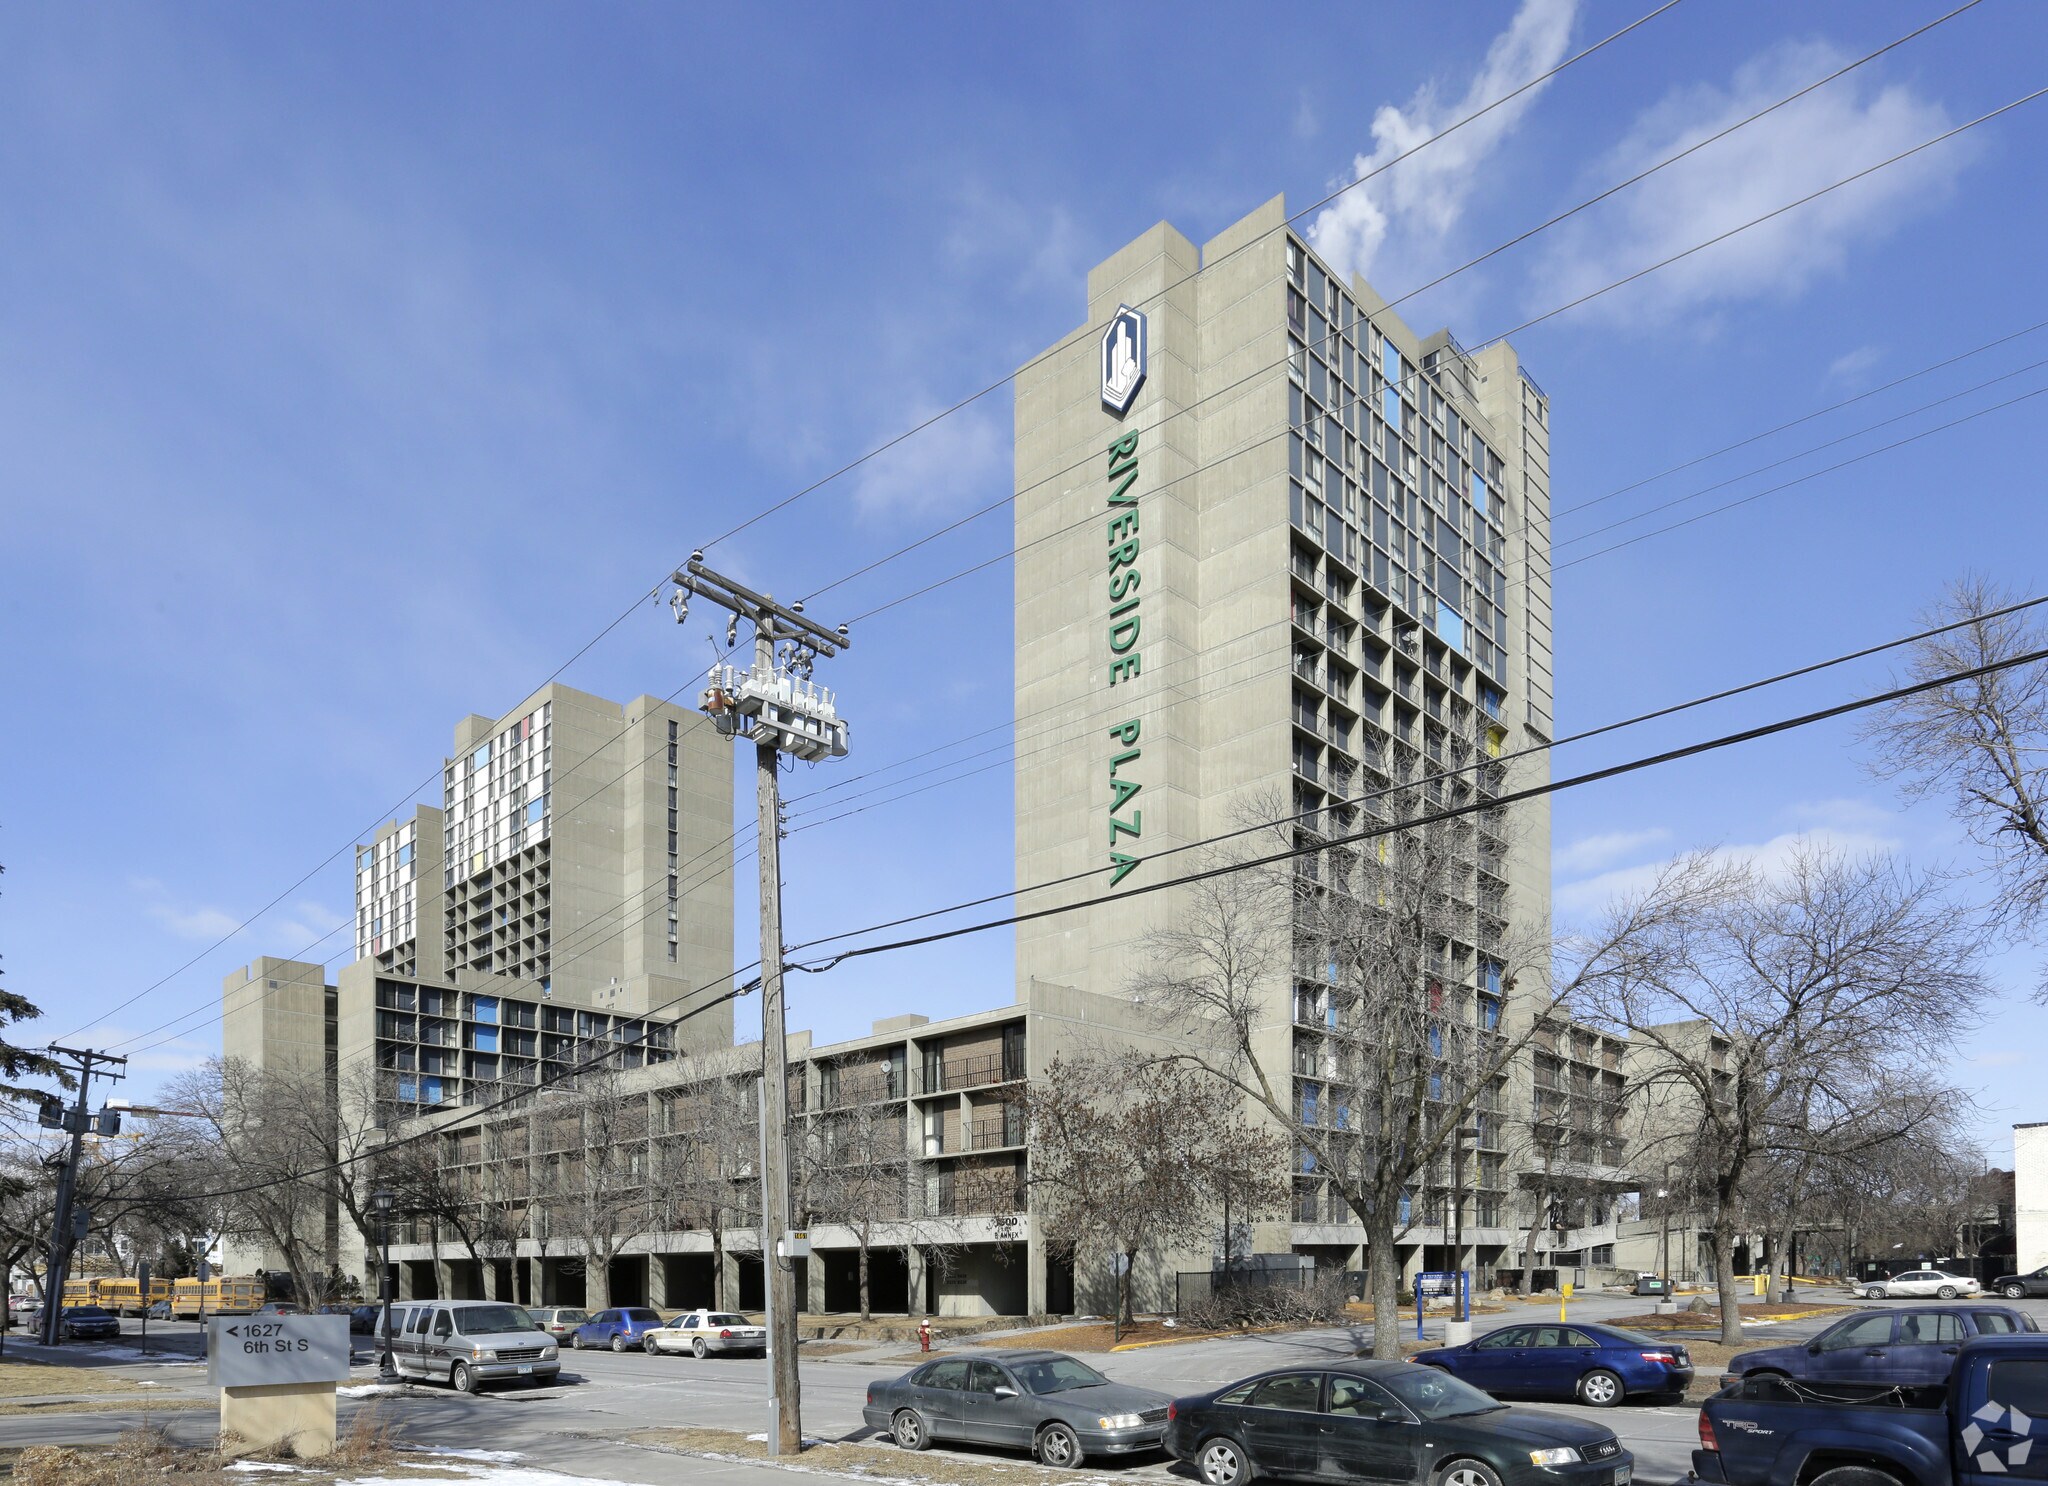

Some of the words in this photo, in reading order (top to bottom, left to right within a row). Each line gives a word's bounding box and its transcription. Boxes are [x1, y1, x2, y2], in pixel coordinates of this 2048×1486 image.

[1107, 428, 1142, 686] RIVERSIDE
[1109, 719, 1142, 888] PLAZA
[1000, 1231, 1019, 1239] ANNEX
[243, 1324, 283, 1337] 1627
[244, 1341, 269, 1354] 6th
[275, 1340, 292, 1353] St
[297, 1339, 309, 1352] S
[1722, 1419, 1758, 1430] TRD
